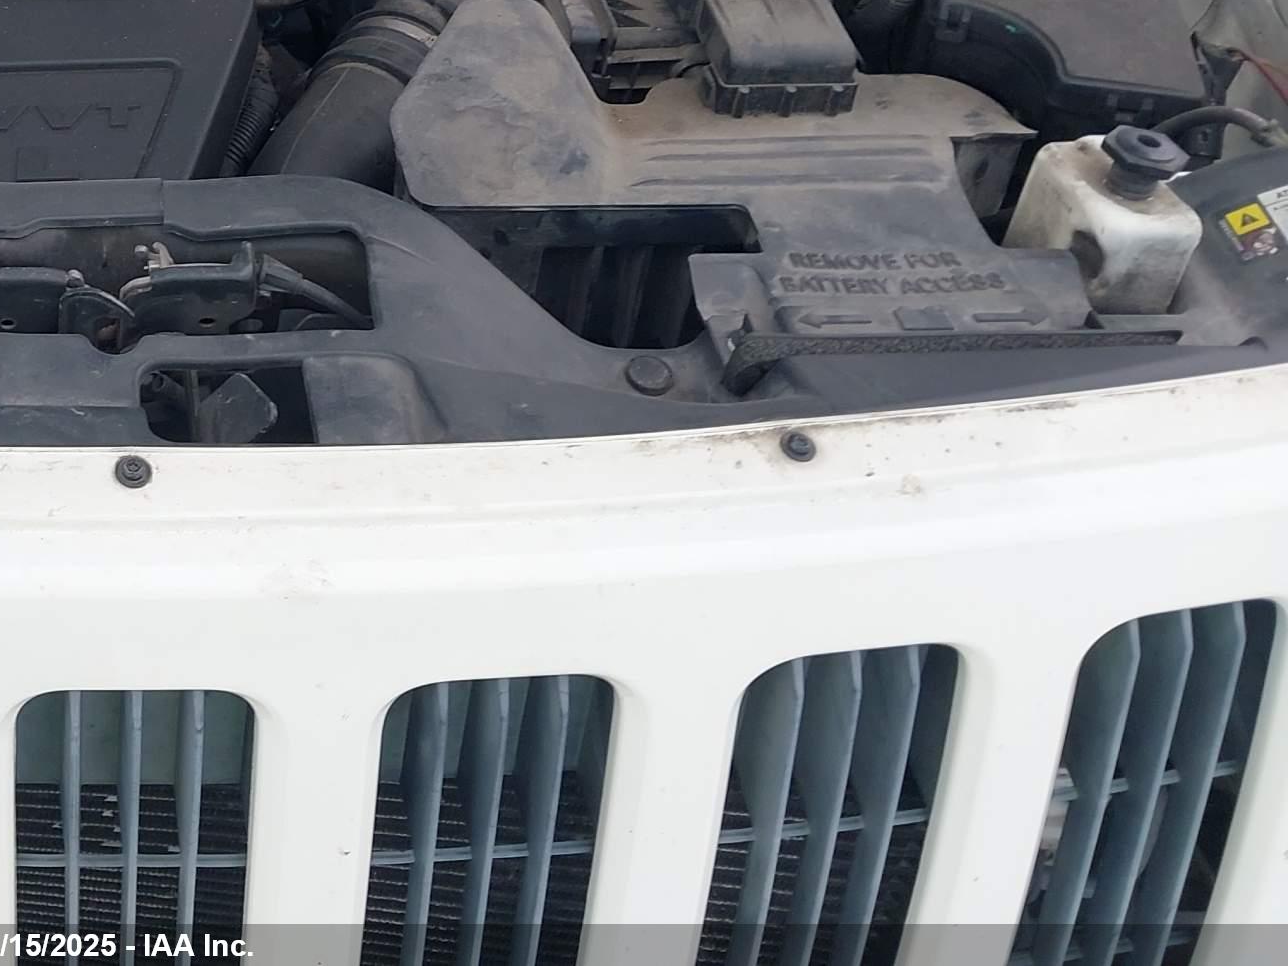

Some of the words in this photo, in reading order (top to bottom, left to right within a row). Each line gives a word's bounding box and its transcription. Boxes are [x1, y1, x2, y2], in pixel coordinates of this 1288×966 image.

[787, 252, 901, 271] REMOVE
[903, 251, 961, 270] FOR
[778, 275, 889, 295] BATTERY
[899, 272, 1005, 295] ACCESS
